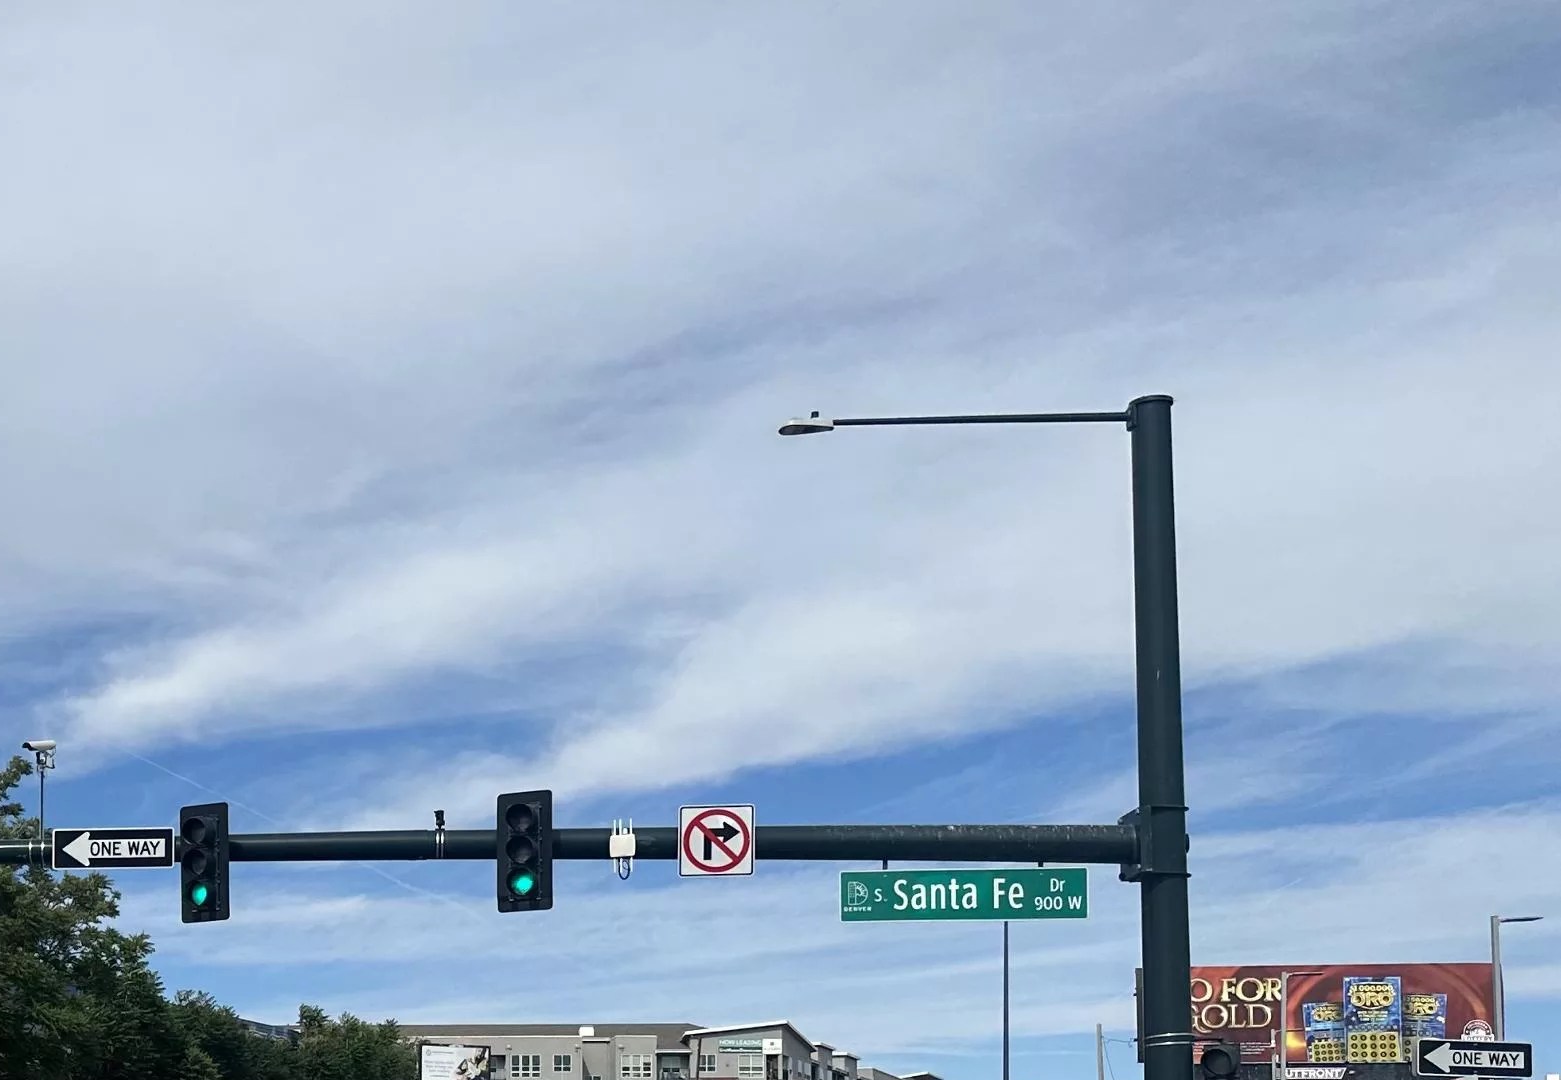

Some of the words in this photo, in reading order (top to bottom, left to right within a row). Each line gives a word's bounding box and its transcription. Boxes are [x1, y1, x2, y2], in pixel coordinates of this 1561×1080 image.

[90, 842, 121, 856] ONE
[128, 841, 160, 856] WAY
[873, 888, 888, 903] S.
[893, 878, 978, 911] Santa
[993, 877, 1024, 909] Fe
[1049, 877, 1066, 893] Dr
[1034, 895, 1063, 911] 900
[1067, 895, 1082, 910] W
[1220, 977, 1282, 1002] FOR
[1452, 1051, 1483, 1066] ONE
[1488, 1053, 1520, 1067] WAY
[1285, 1068, 1343, 1080] UTFRONT
